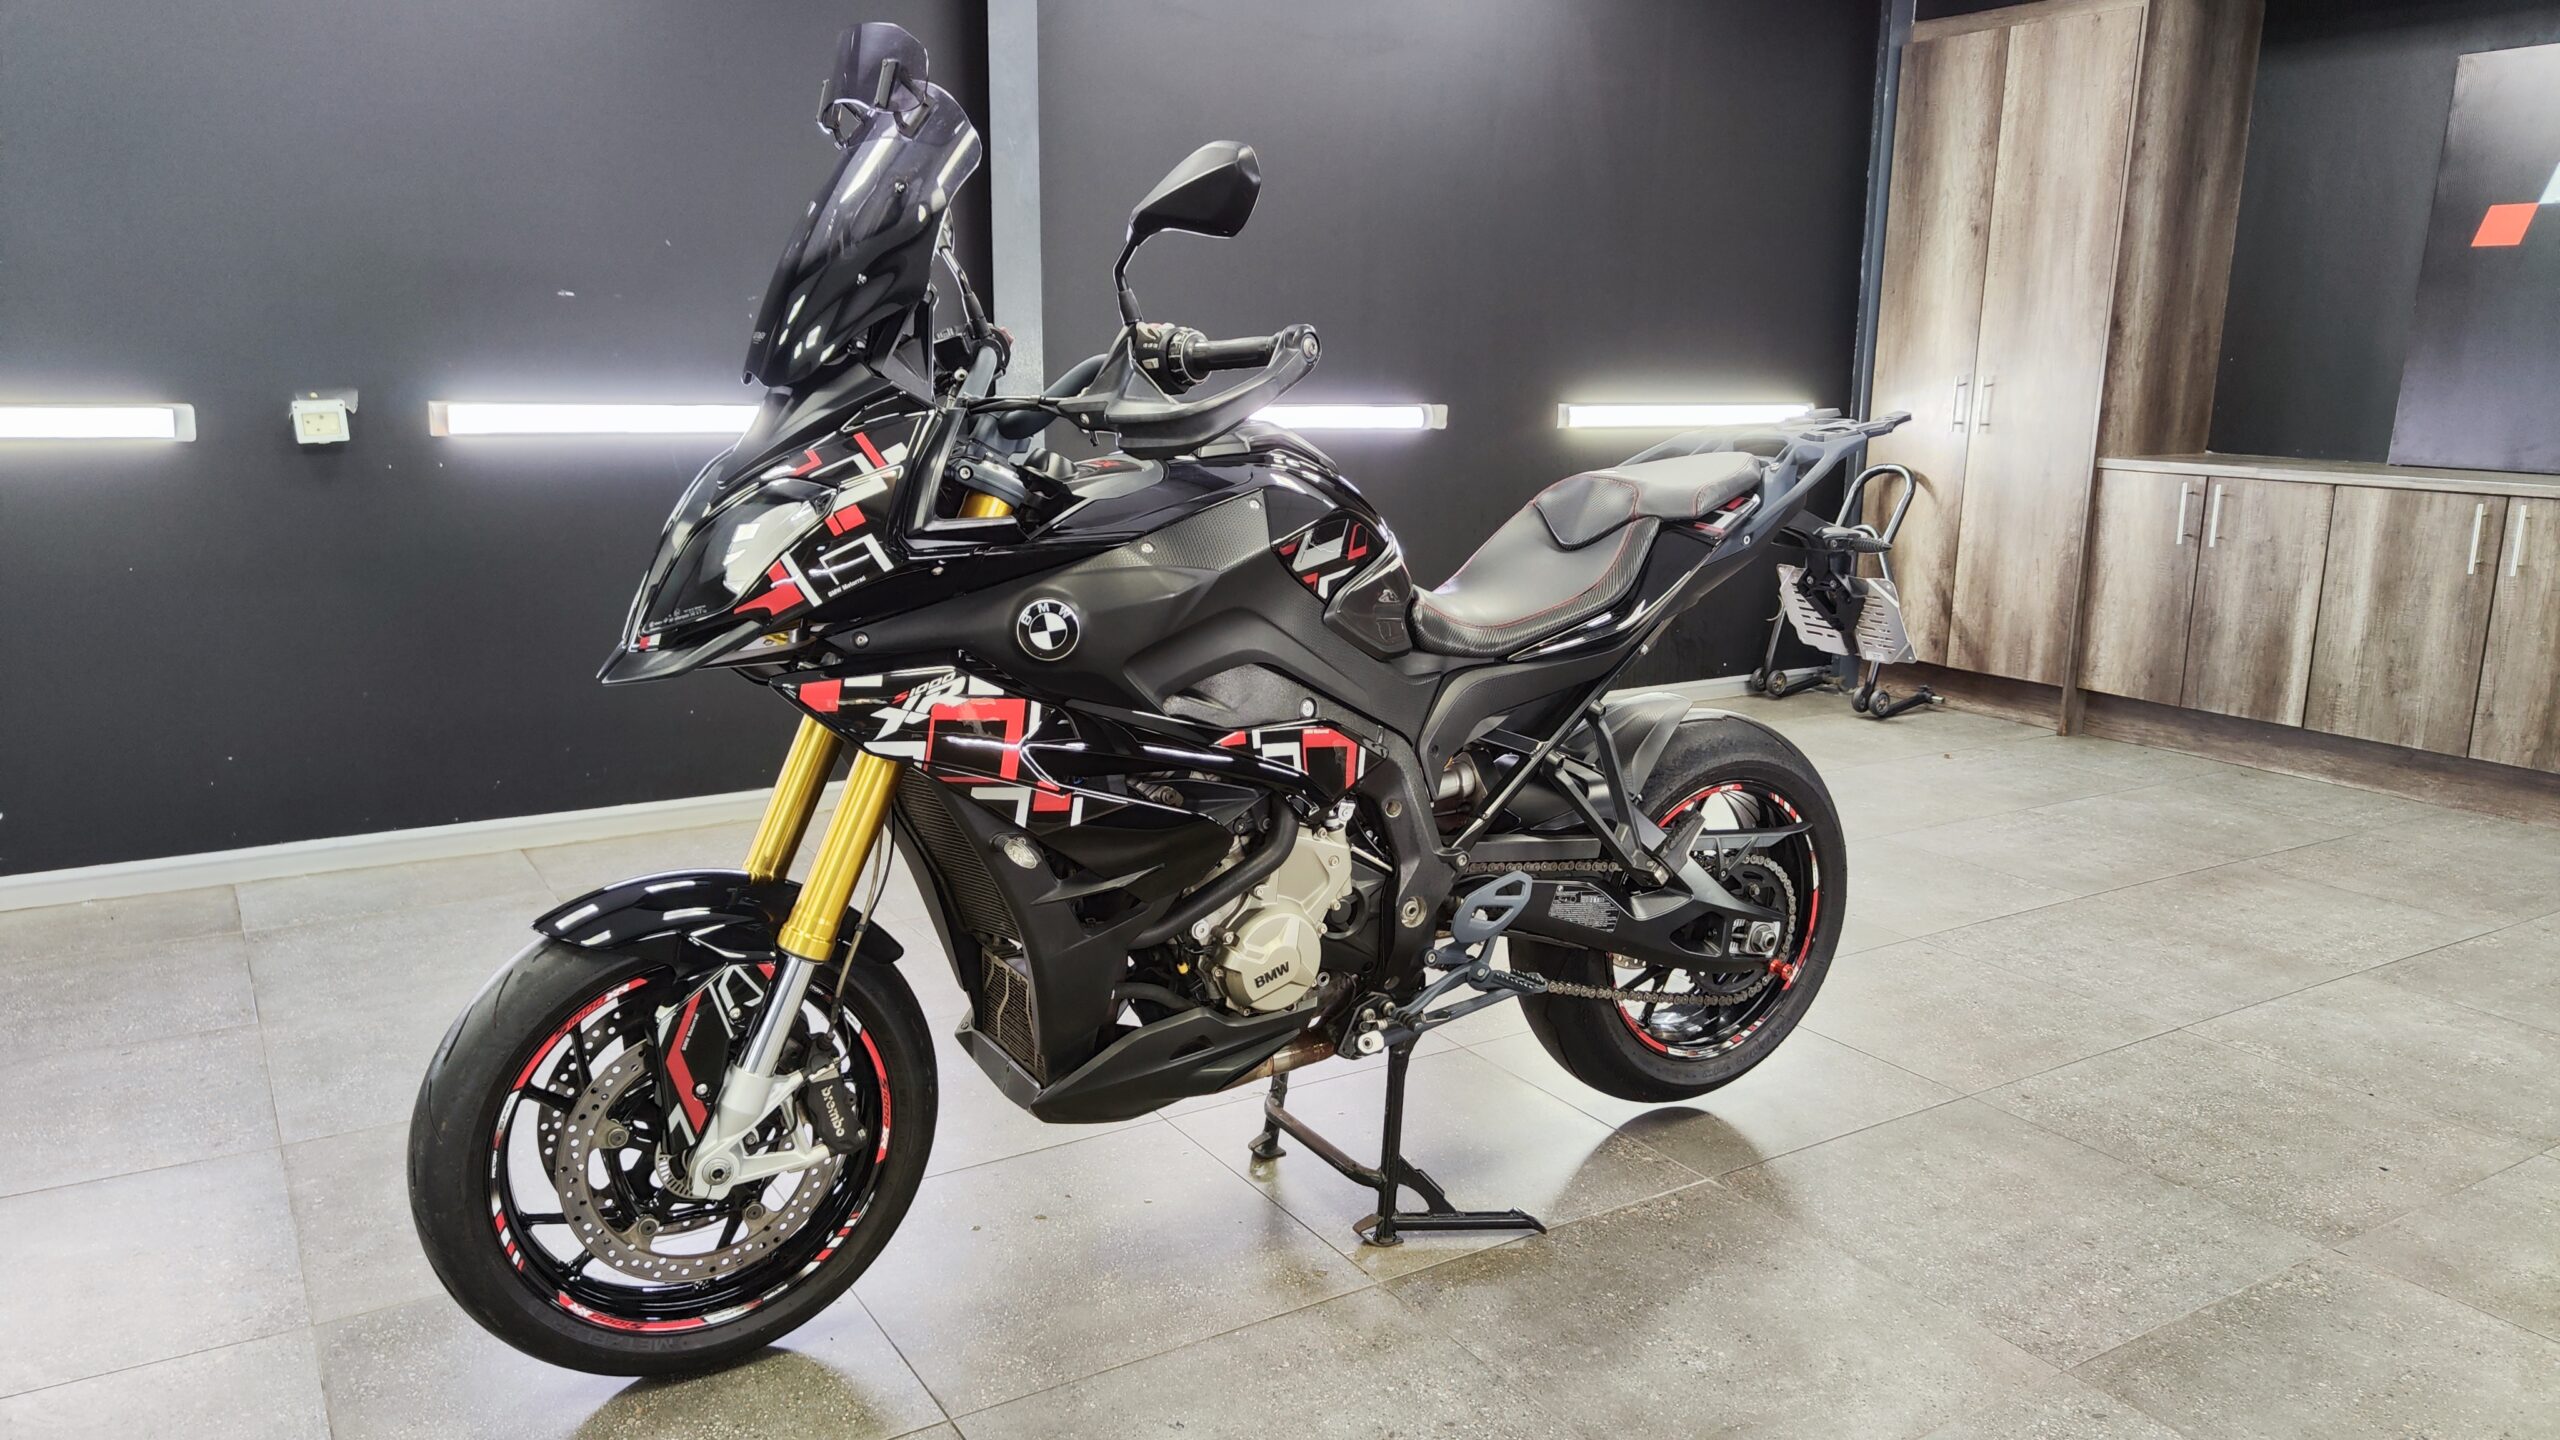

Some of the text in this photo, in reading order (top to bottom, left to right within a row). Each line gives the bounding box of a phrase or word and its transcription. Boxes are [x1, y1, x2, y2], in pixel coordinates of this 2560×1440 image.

[828, 586, 842, 598] BMW
[1020, 602, 1070, 627] BMW
[891, 671, 957, 704] S1000
[1254, 961, 1290, 989] BMW
[821, 1084, 846, 1137] brembo
[553, 1316, 674, 1351] METZELER
